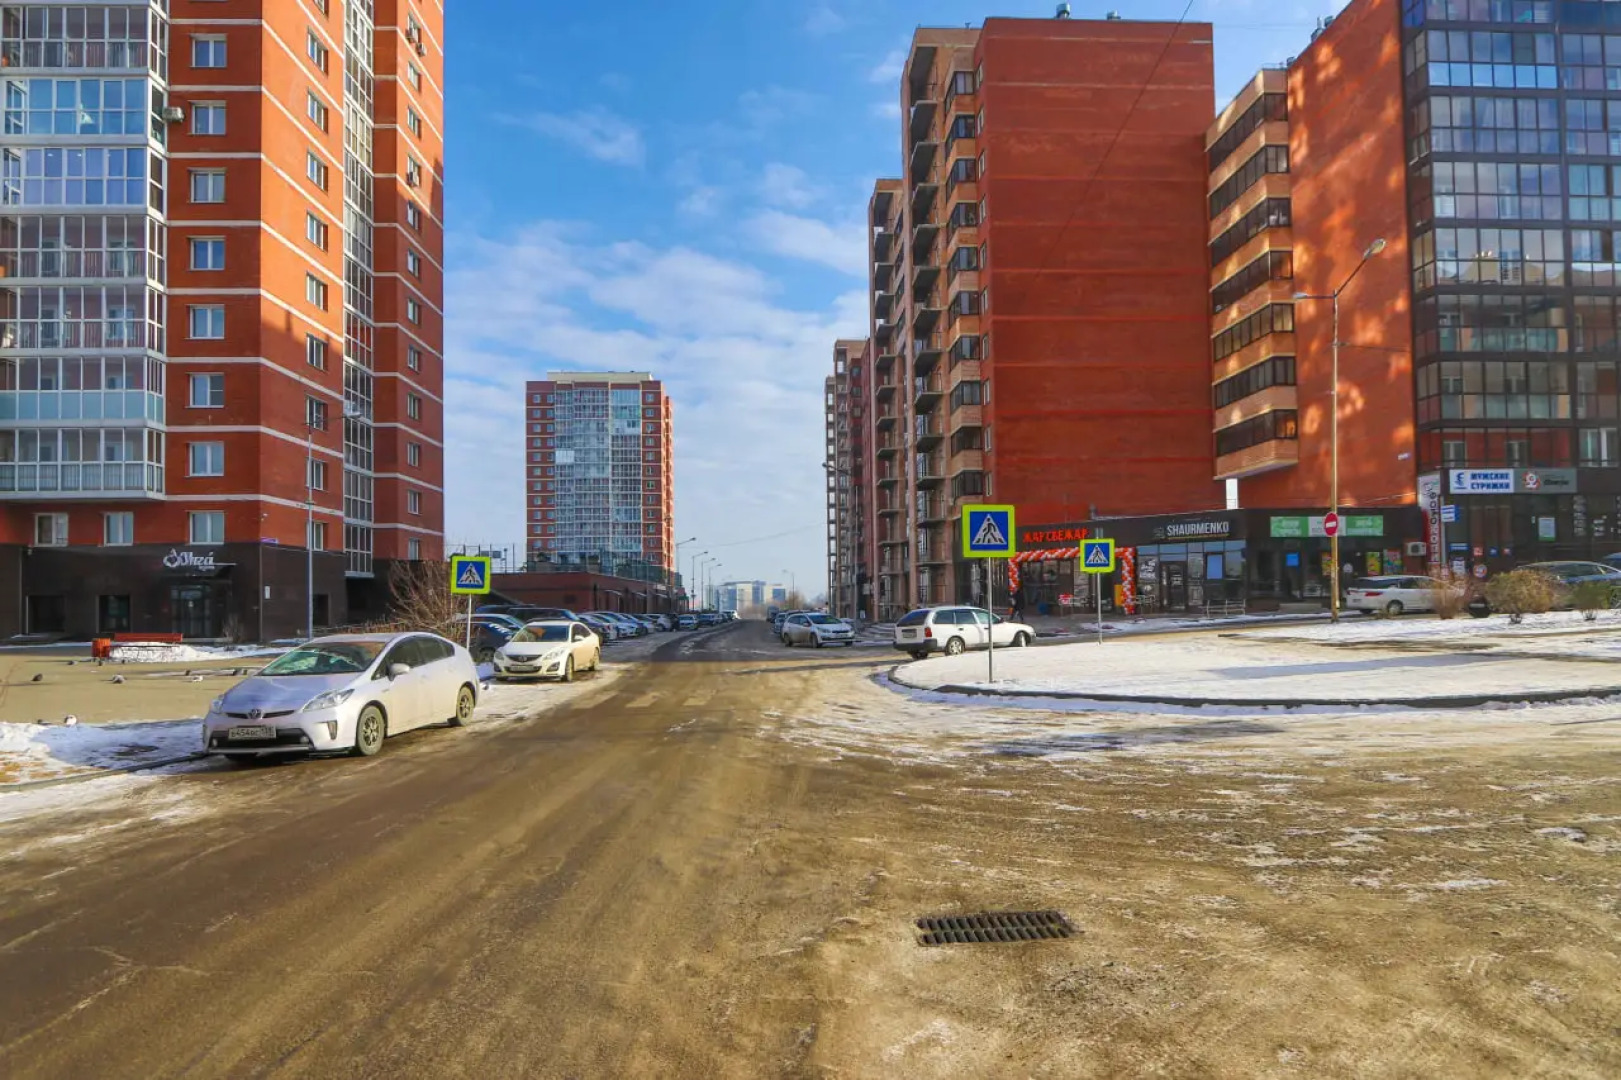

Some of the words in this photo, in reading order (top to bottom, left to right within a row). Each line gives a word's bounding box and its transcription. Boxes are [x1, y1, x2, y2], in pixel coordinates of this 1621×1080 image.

[1470, 471, 1510, 481] МУЖСКИЕ
[1470, 482, 1510, 490] СТРИЖКИ
[1166, 521, 1230, 536] SHAURMENKO
